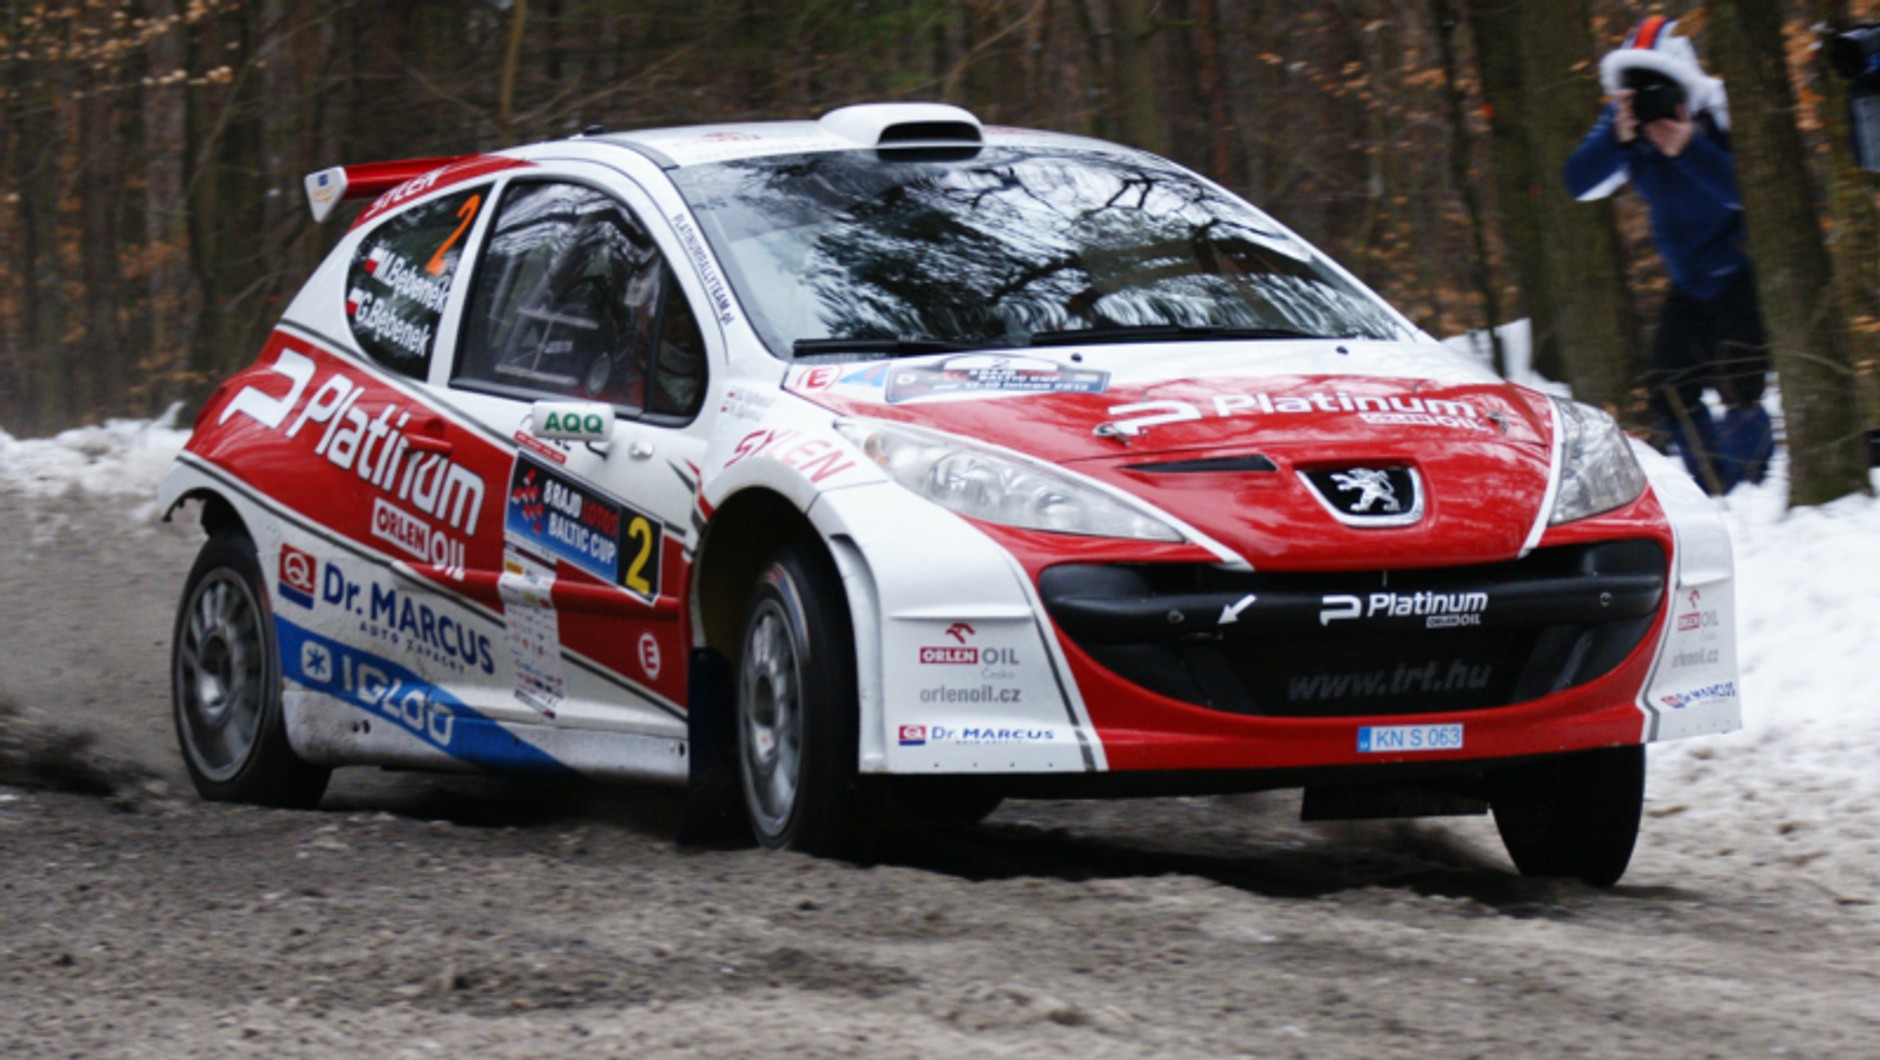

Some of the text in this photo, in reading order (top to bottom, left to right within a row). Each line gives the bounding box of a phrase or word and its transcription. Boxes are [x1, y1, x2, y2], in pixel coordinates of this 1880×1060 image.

[425, 194, 481, 276] 2
[807, 367, 833, 389] E
[1212, 392, 1477, 417] Platinum
[544, 412, 604, 434] AQQ
[1433, 415, 1490, 432] OIL
[285, 372, 485, 536] Platinum
[723, 430, 856, 483] SYLEN
[376, 504, 427, 557] ORLEN
[431, 531, 465, 581] OIL
[548, 512, 588, 553] BALTIC
[589, 532, 616, 565] CUP
[625, 516, 653, 596] 2
[1367, 591, 1488, 617] Platinum
[323, 562, 362, 615] Dr.
[371, 581, 494, 675] MARCUS
[1460, 614, 1481, 626] OIL
[359, 621, 399, 645] AUTO
[644, 640, 657, 669] E
[922, 647, 1020, 665] ORLEN OIL
[343, 654, 455, 746] IGLOO
[920, 685, 1021, 703] orlenoil.cz
[963, 728, 1054, 740] MARCUS
[1376, 728, 1461, 748] KN S 063
